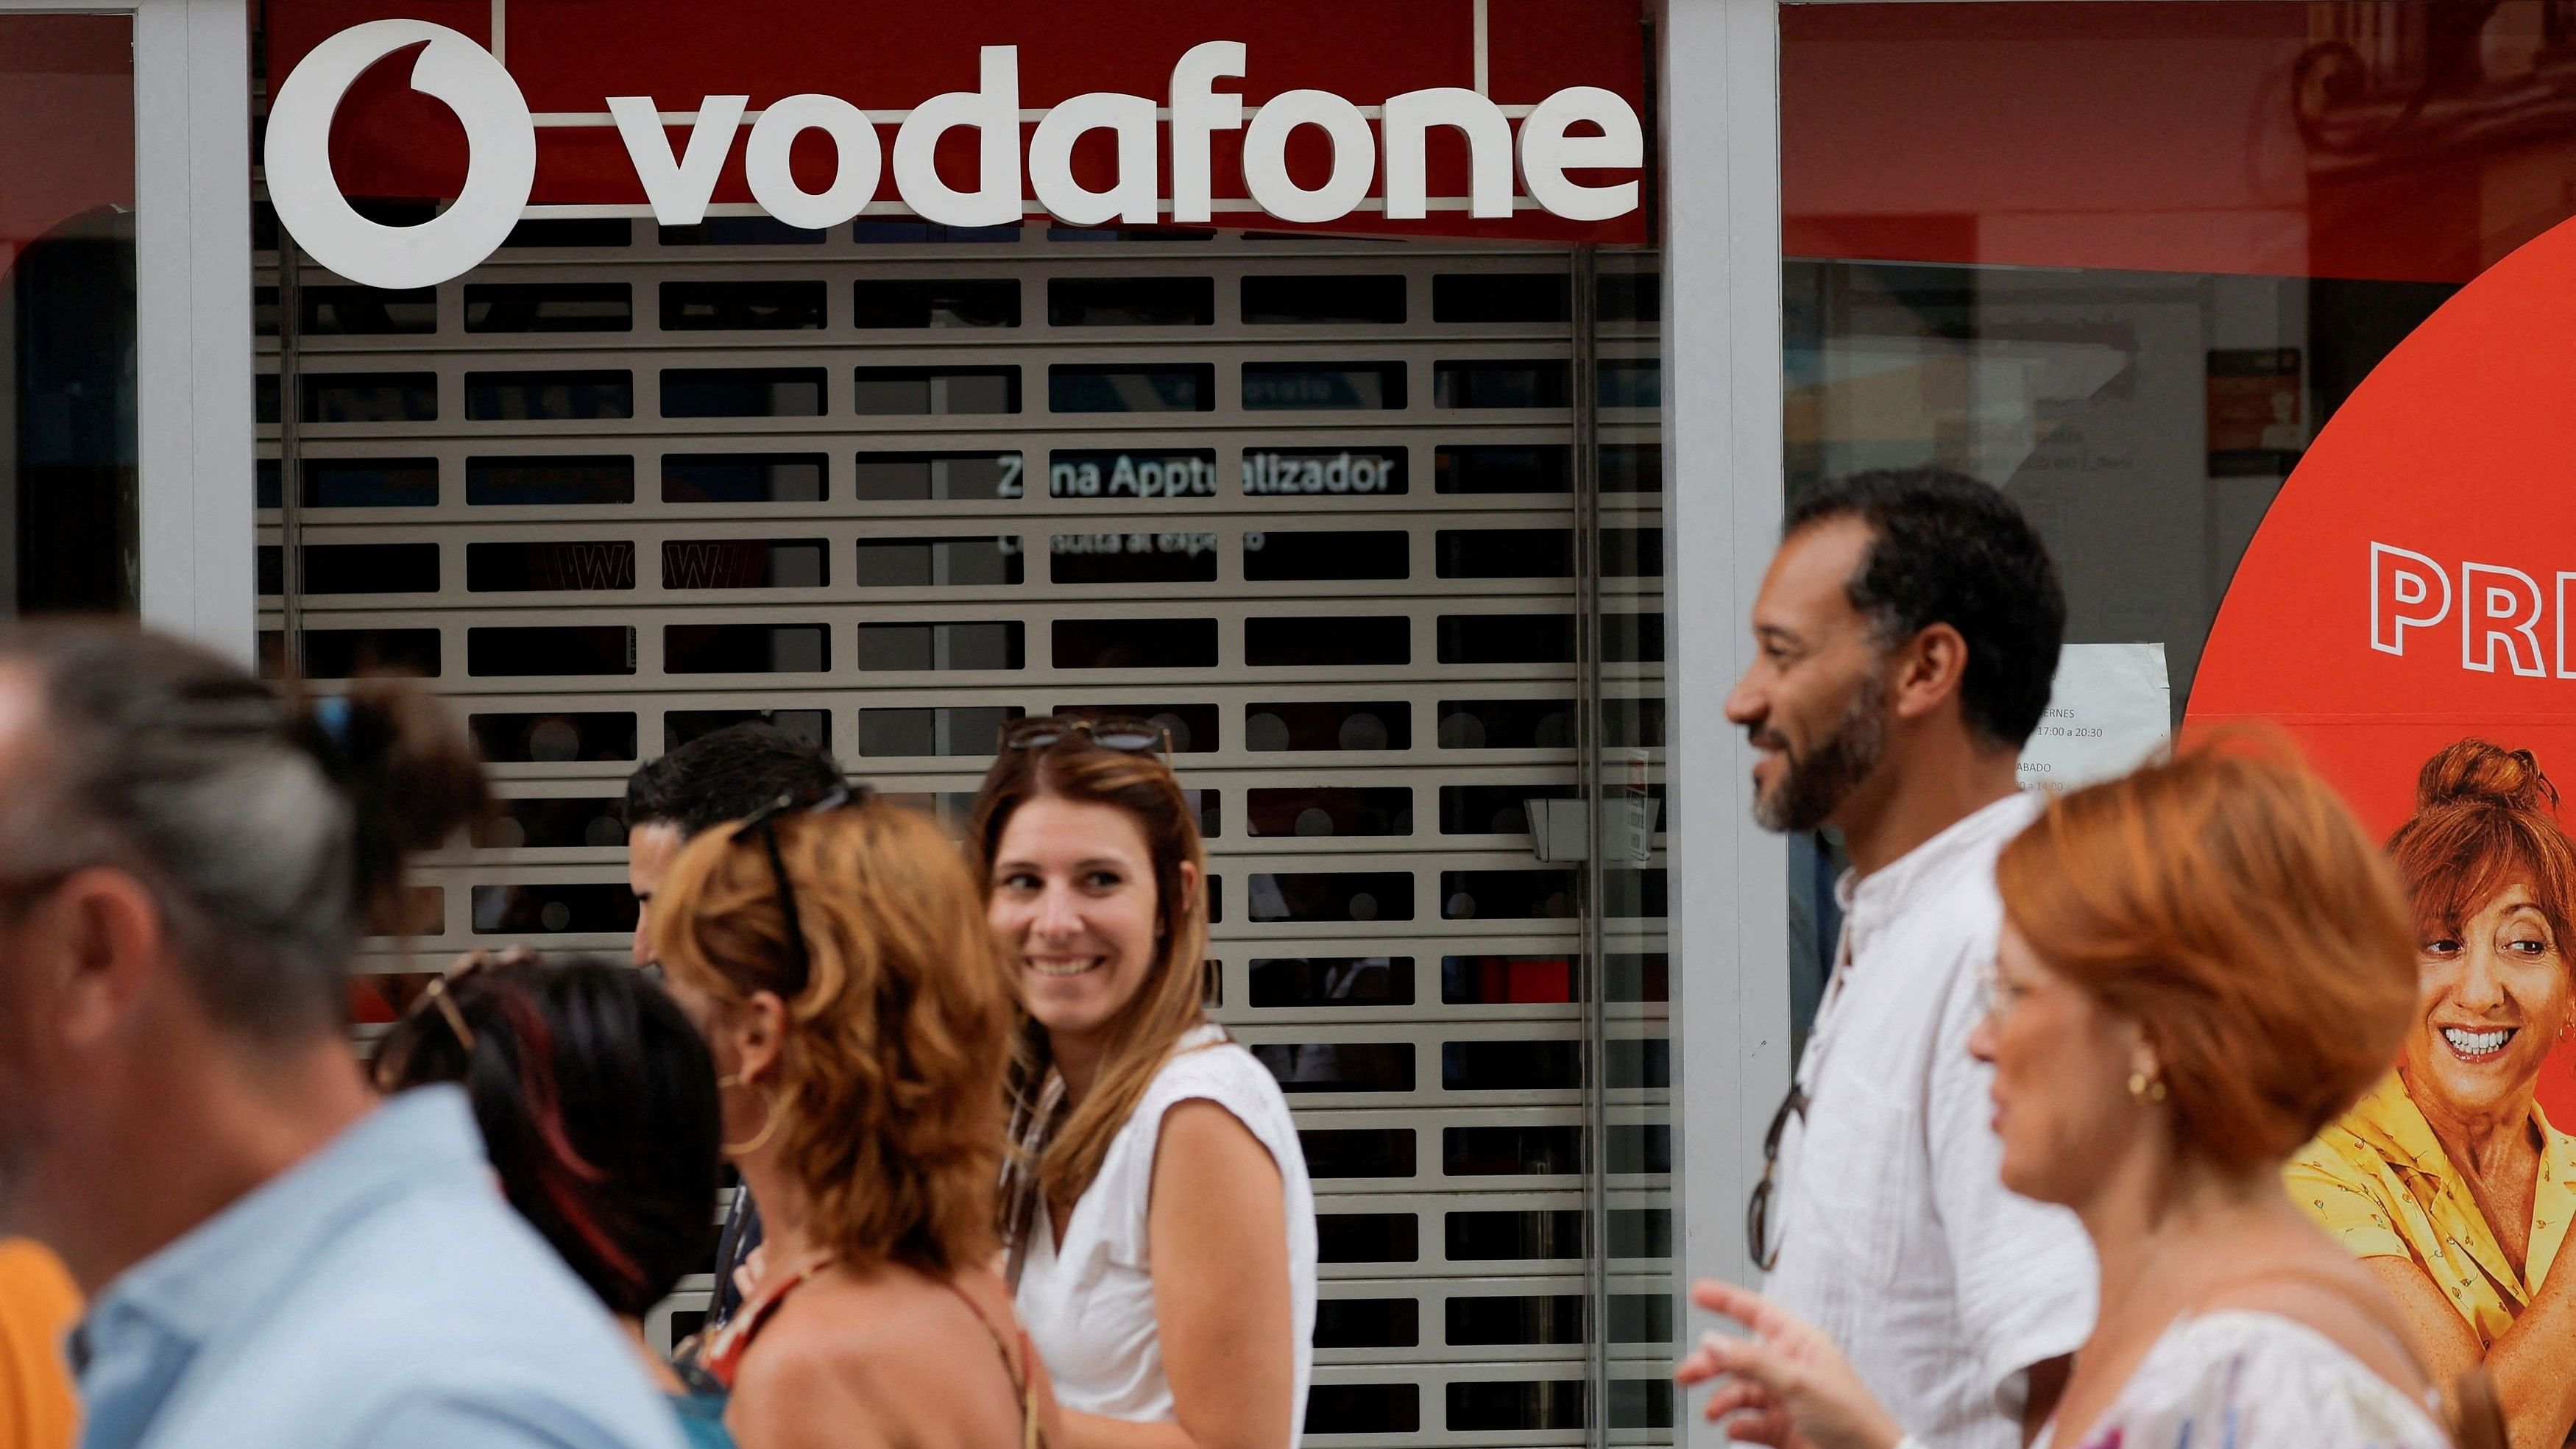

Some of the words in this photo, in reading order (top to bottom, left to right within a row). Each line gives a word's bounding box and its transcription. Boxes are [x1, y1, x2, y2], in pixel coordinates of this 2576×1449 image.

[606, 40, 1643, 229] vodafone
[997, 453, 1102, 497] Zna
[2044, 707, 2075, 718] ERNES
[2037, 726, 2064, 736] 17:00
[2076, 727, 2103, 737] 20:30
[2017, 762, 2051, 773] ABADO
